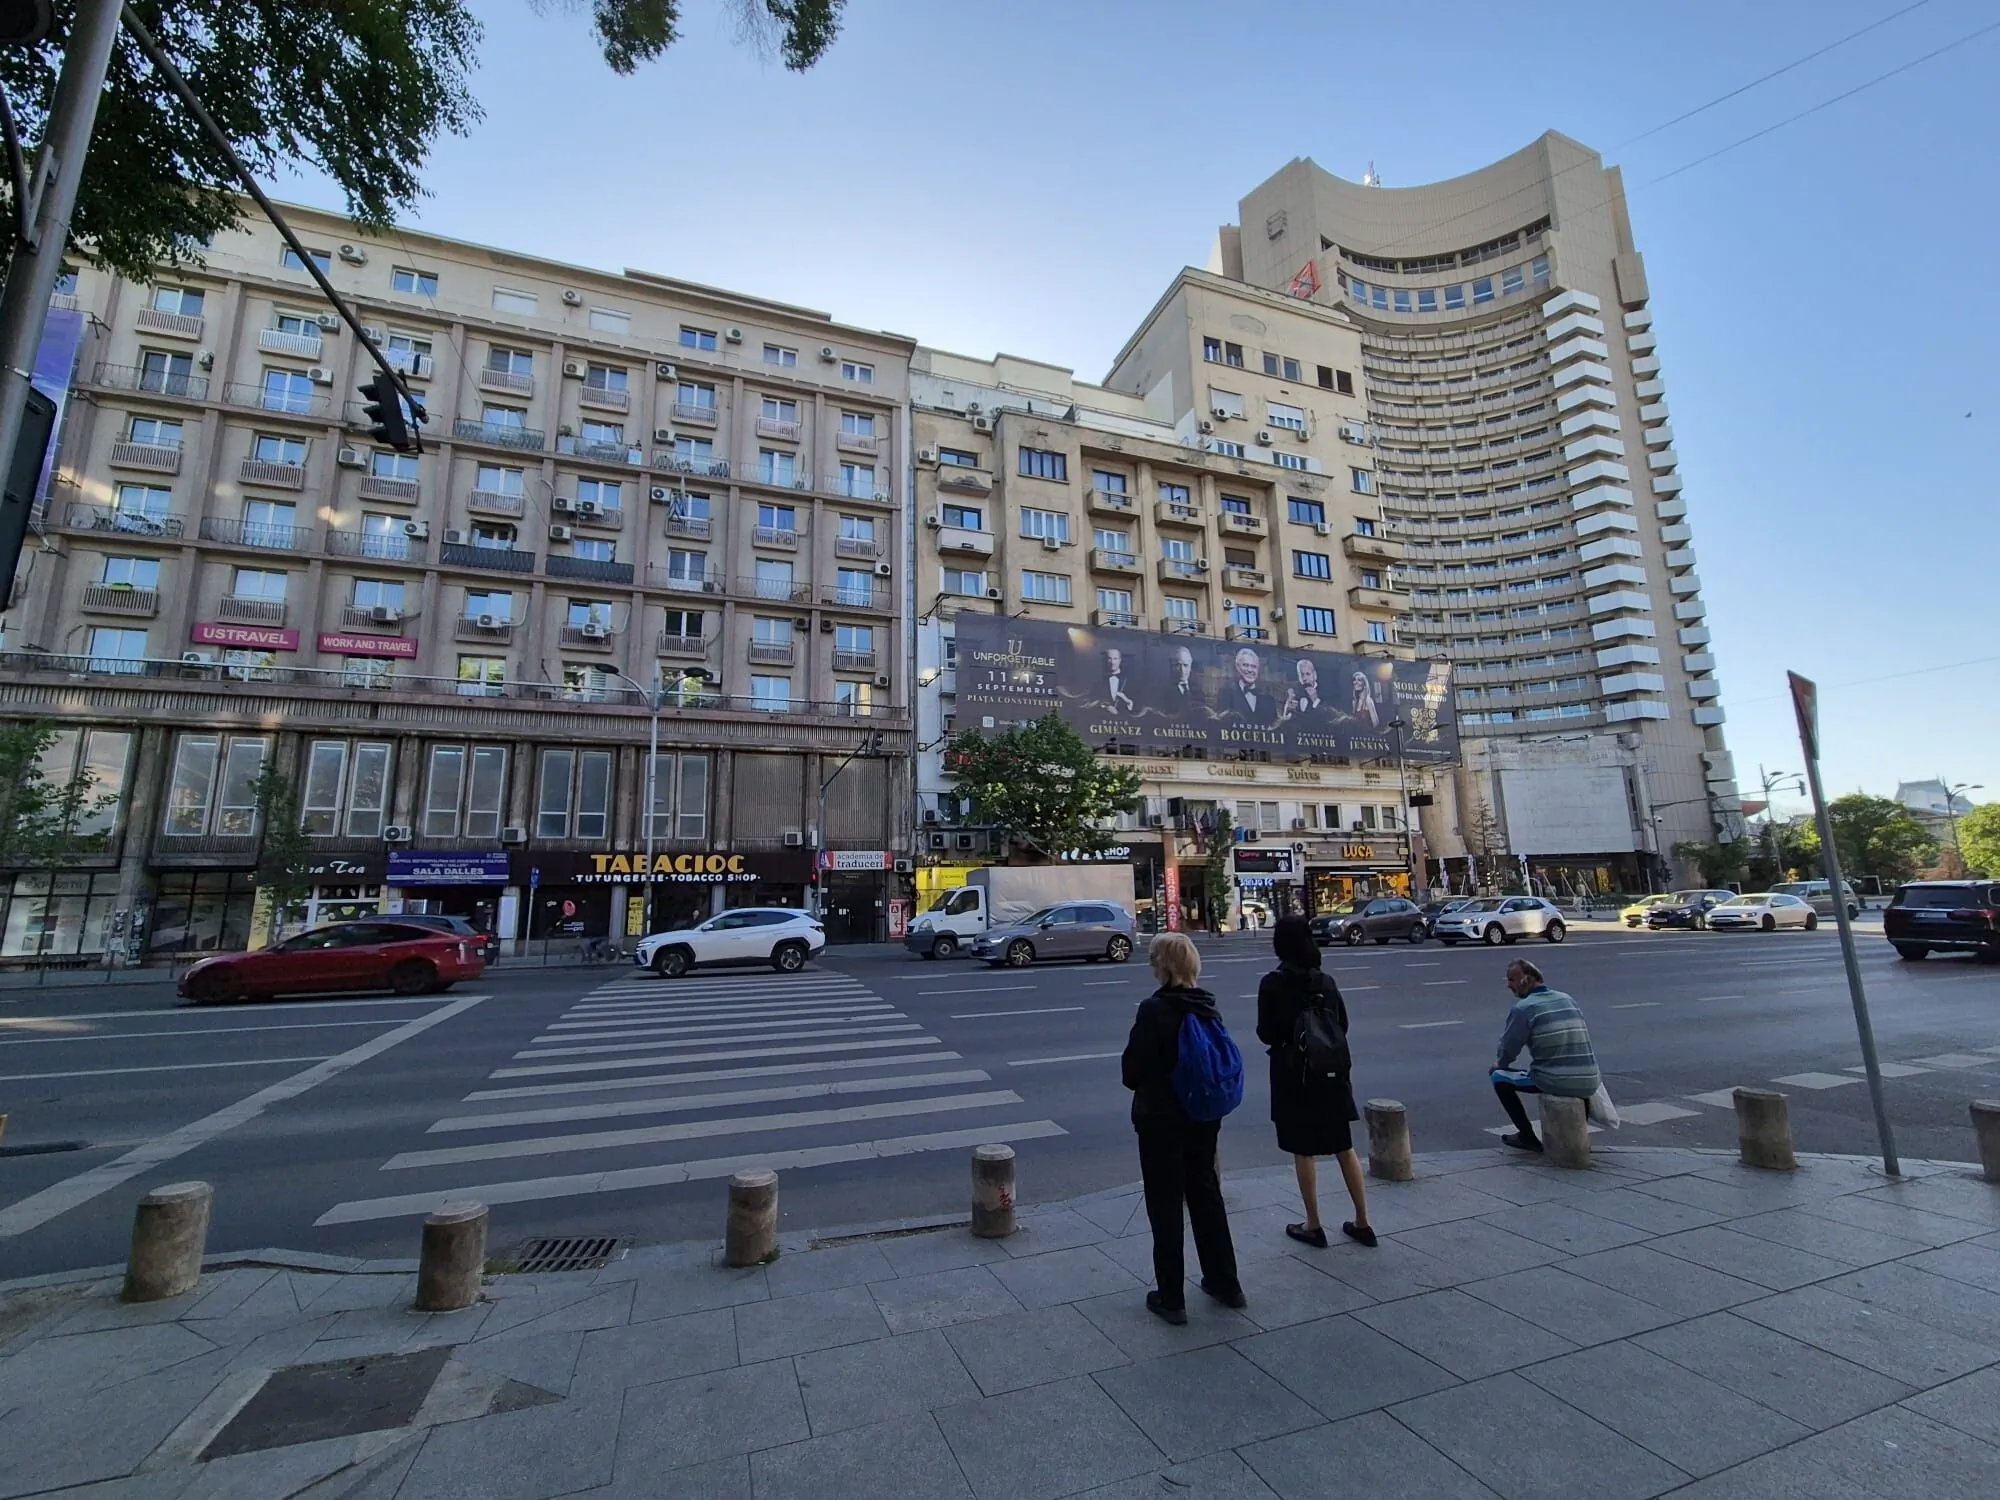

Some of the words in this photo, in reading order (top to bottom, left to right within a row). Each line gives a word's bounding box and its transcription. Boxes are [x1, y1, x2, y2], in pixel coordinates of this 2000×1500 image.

[203, 627, 288, 645] USTRAVEL
[324, 637, 353, 648] WORK
[355, 640, 375, 650] AND
[378, 642, 412, 653] TRAVEL
[973, 651, 1056, 667] UNFORGETTABLE
[977, 683, 1054, 695] SEPTEMBRIE
[1393, 681, 1418, 692] MORE
[1153, 728, 1208, 739] CARRERAS
[1221, 729, 1284, 745] BOCELLI
[1297, 736, 1336, 749] ZAMFIR
[1349, 740, 1390, 751] JENKINS
[837, 852, 872, 860] academia
[874, 852, 884, 860] de
[1103, 846, 1131, 857] SHOP
[1343, 845, 1375, 858] LUCA
[330, 860, 366, 874] Tea
[590, 854, 745, 873] TABACIOC
[837, 859, 883, 868] traduceri
[413, 867, 441, 875] SALA
[444, 867, 485, 875] DALLES
[670, 874, 723, 882] TOBACCO
[727, 873, 757, 882] SHOP
